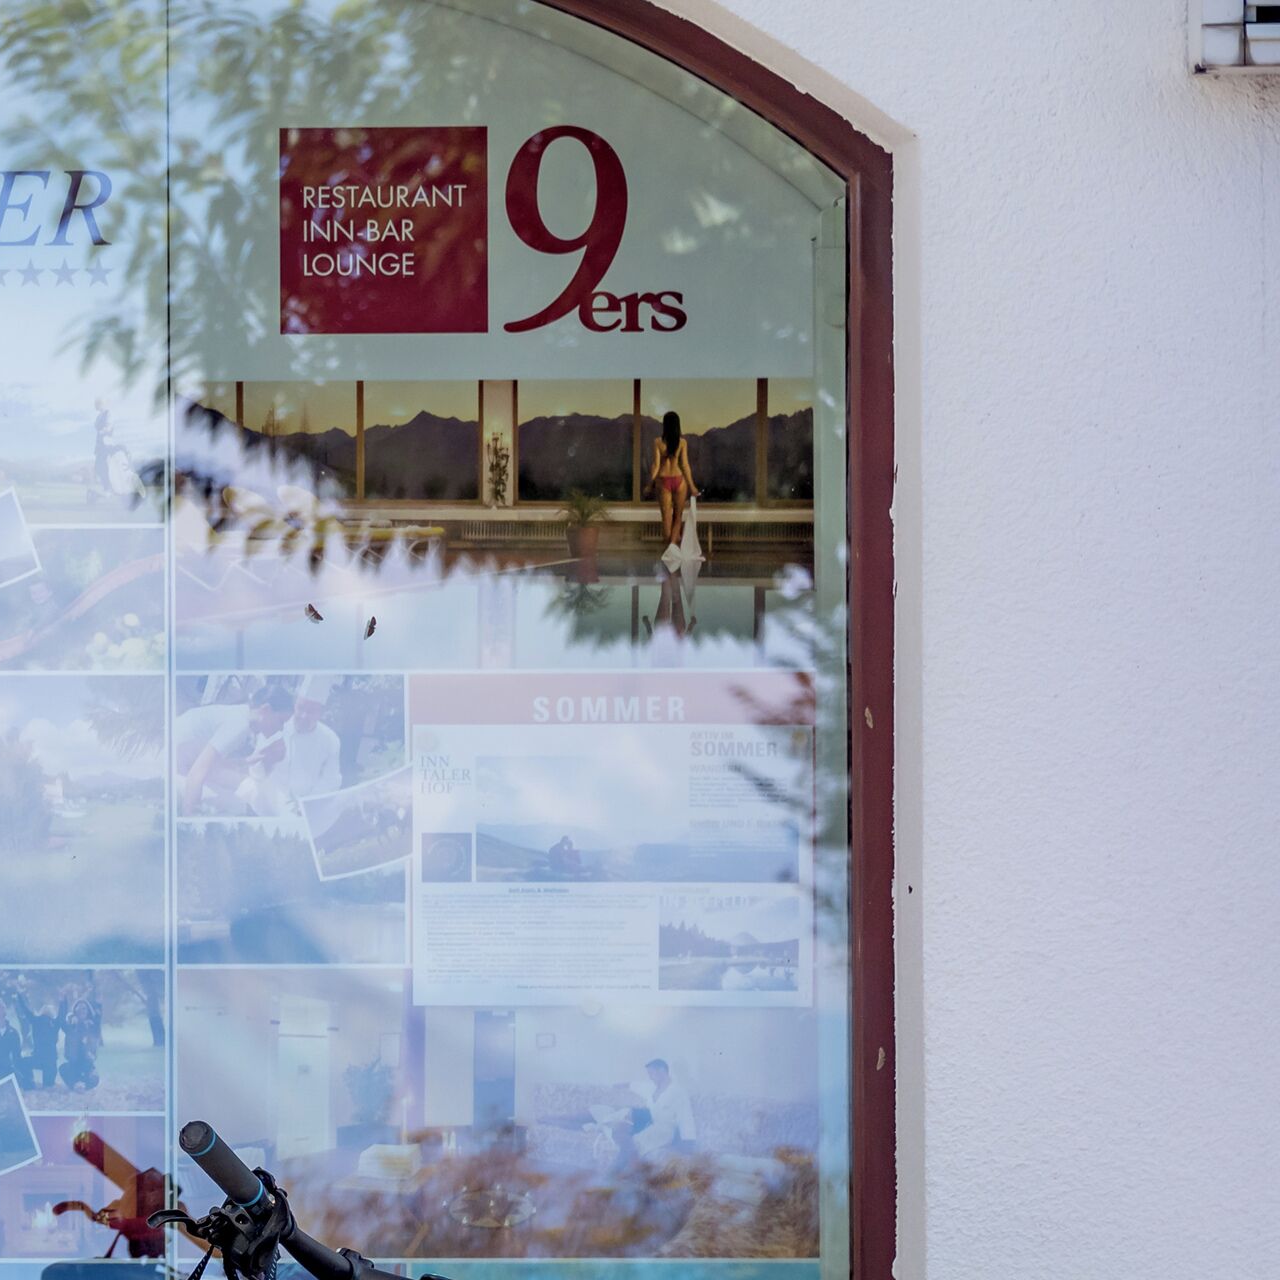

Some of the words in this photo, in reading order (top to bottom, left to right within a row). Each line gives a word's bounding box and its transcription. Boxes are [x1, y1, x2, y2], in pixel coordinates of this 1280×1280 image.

[302, 184, 467, 210] RESTAURANT
[302, 219, 415, 243] INN-BAR
[302, 252, 415, 277] LOUNGE
[532, 696, 687, 723] SOMMER
[690, 742, 778, 757] SOMMER
[420, 755, 450, 768] INN
[420, 769, 471, 781] TALER
[420, 782, 454, 794] HOF
